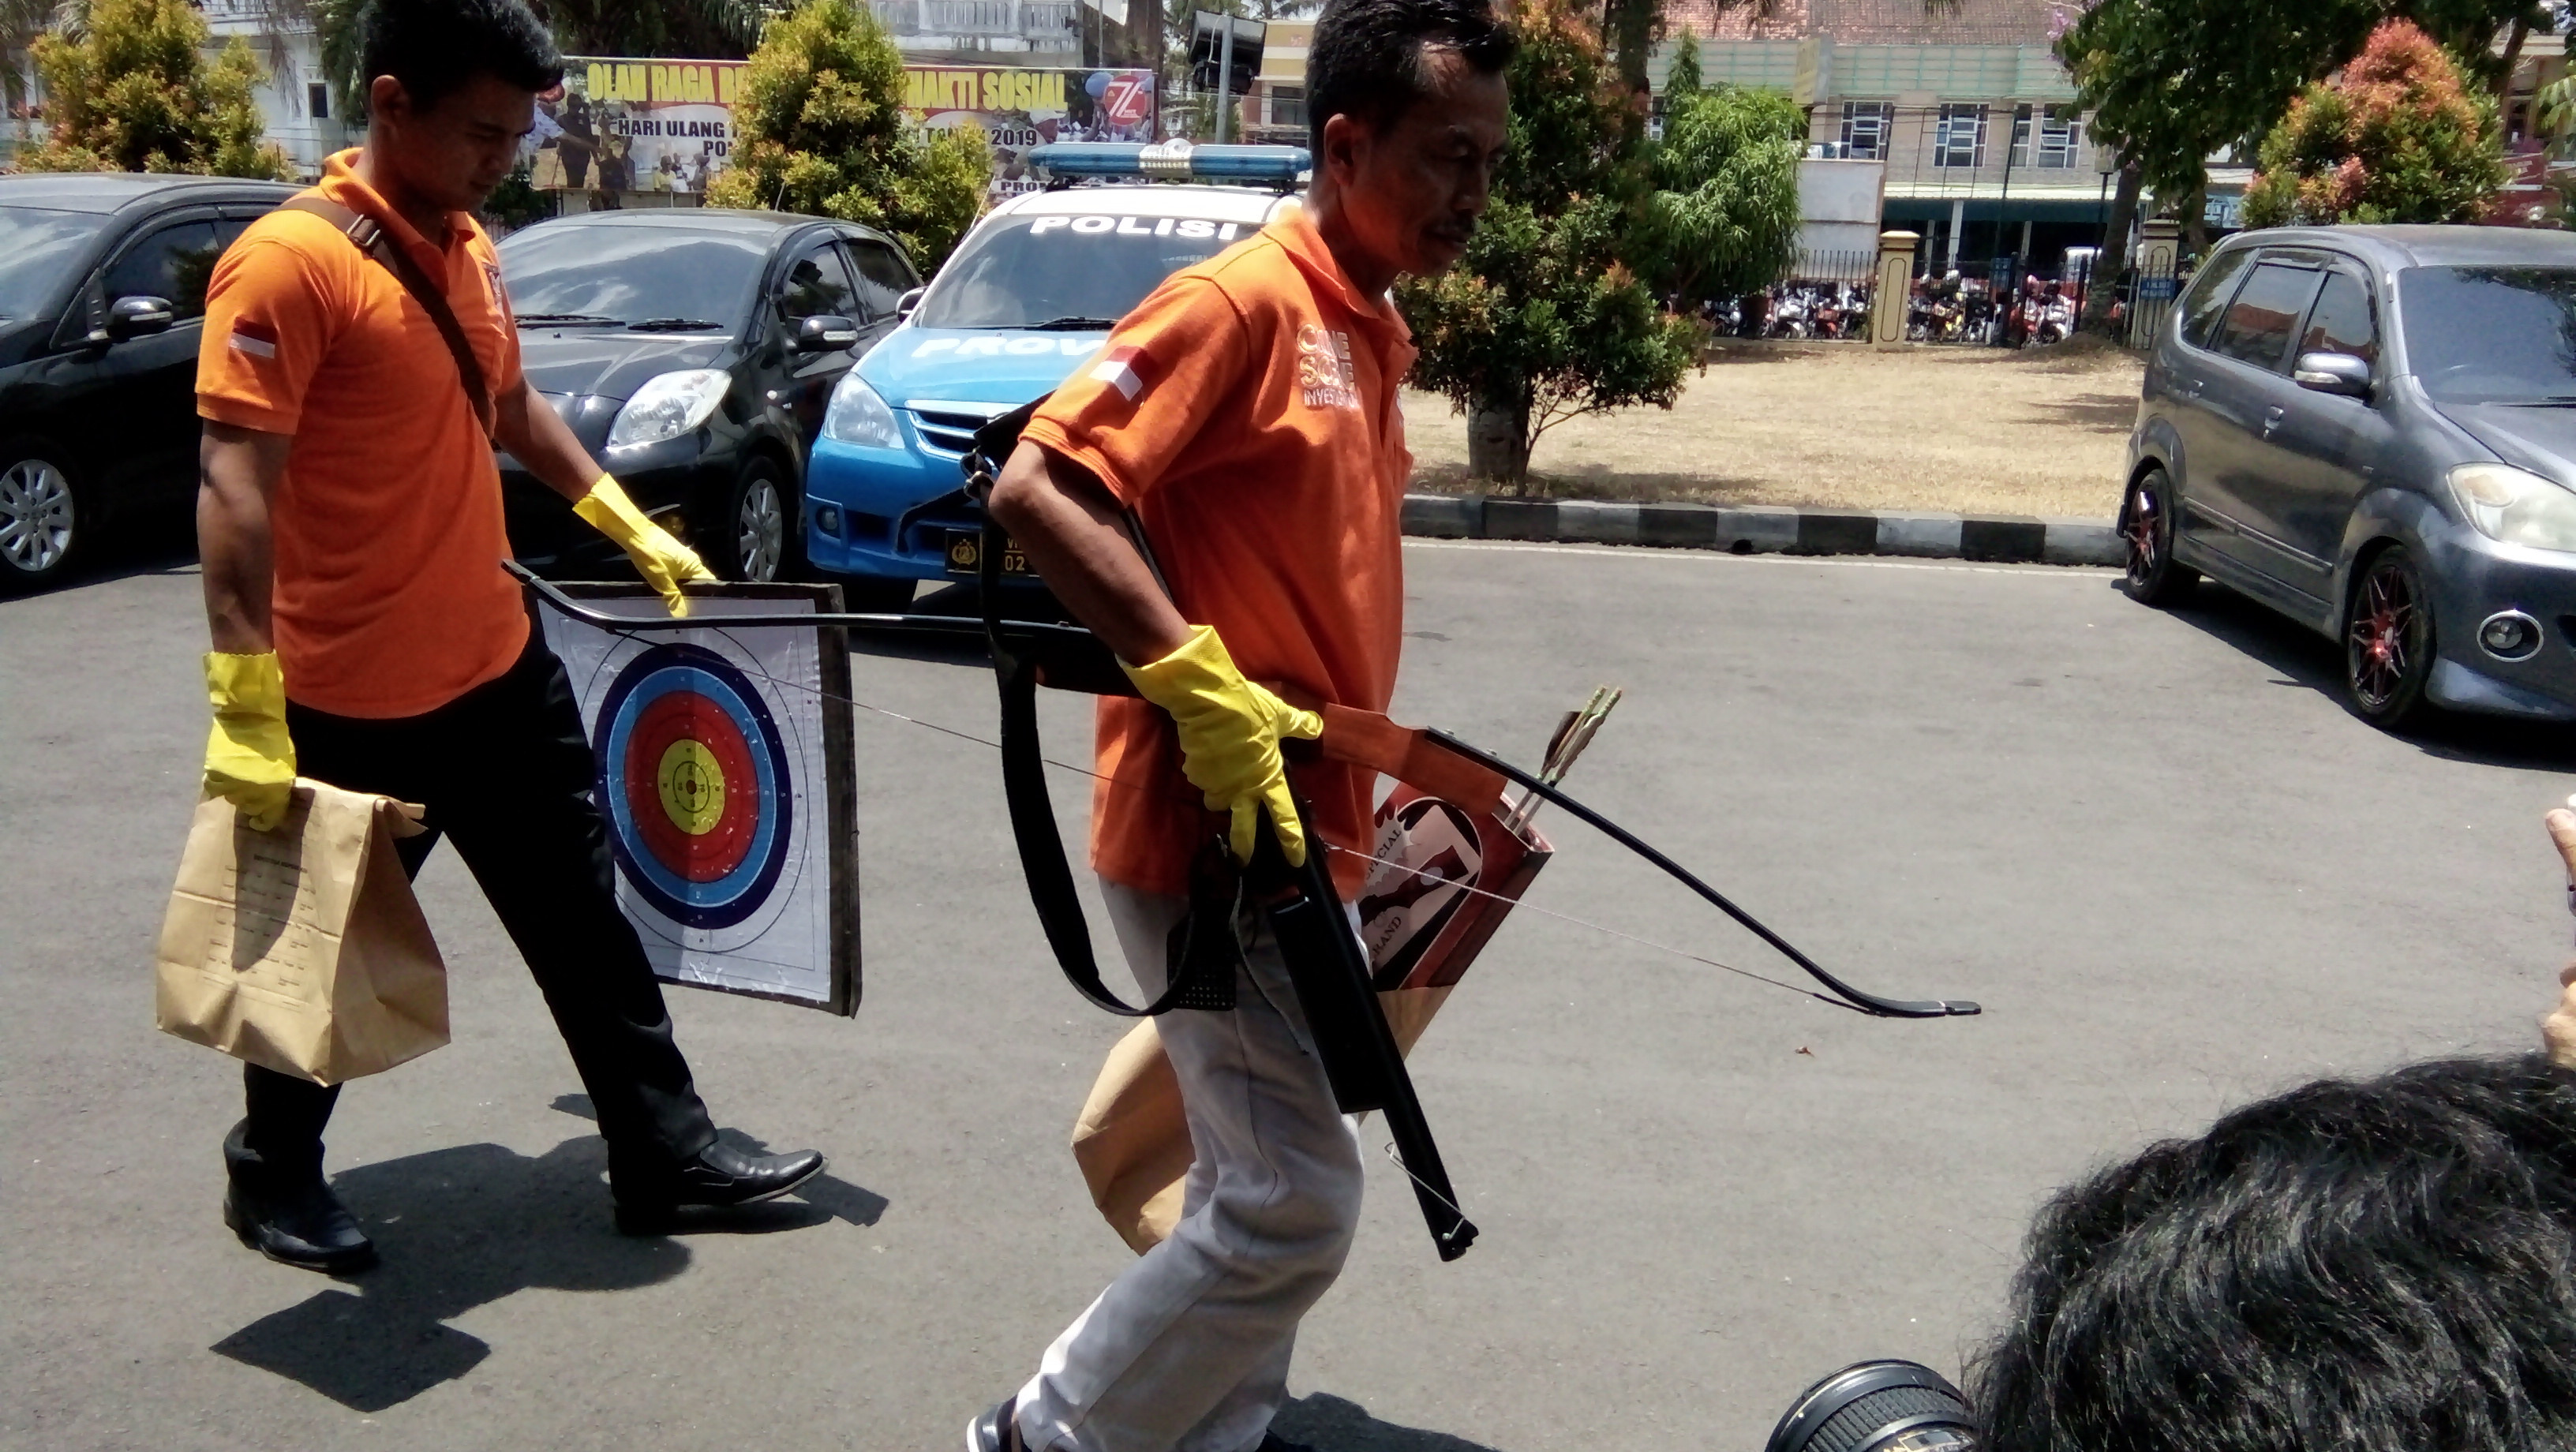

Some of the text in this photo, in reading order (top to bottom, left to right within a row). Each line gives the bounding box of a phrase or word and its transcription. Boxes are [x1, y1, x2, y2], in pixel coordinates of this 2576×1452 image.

[587, 63, 647, 101] OLAH
[650, 65, 715, 103] RAGA
[982, 72, 1069, 110] SOSIAL
[618, 119, 661, 136] HARI
[666, 120, 724, 138] ULANG
[991, 129, 1037, 146] 2019
[1029, 216, 1238, 241] POLISI
[911, 336, 1106, 357] PROV
